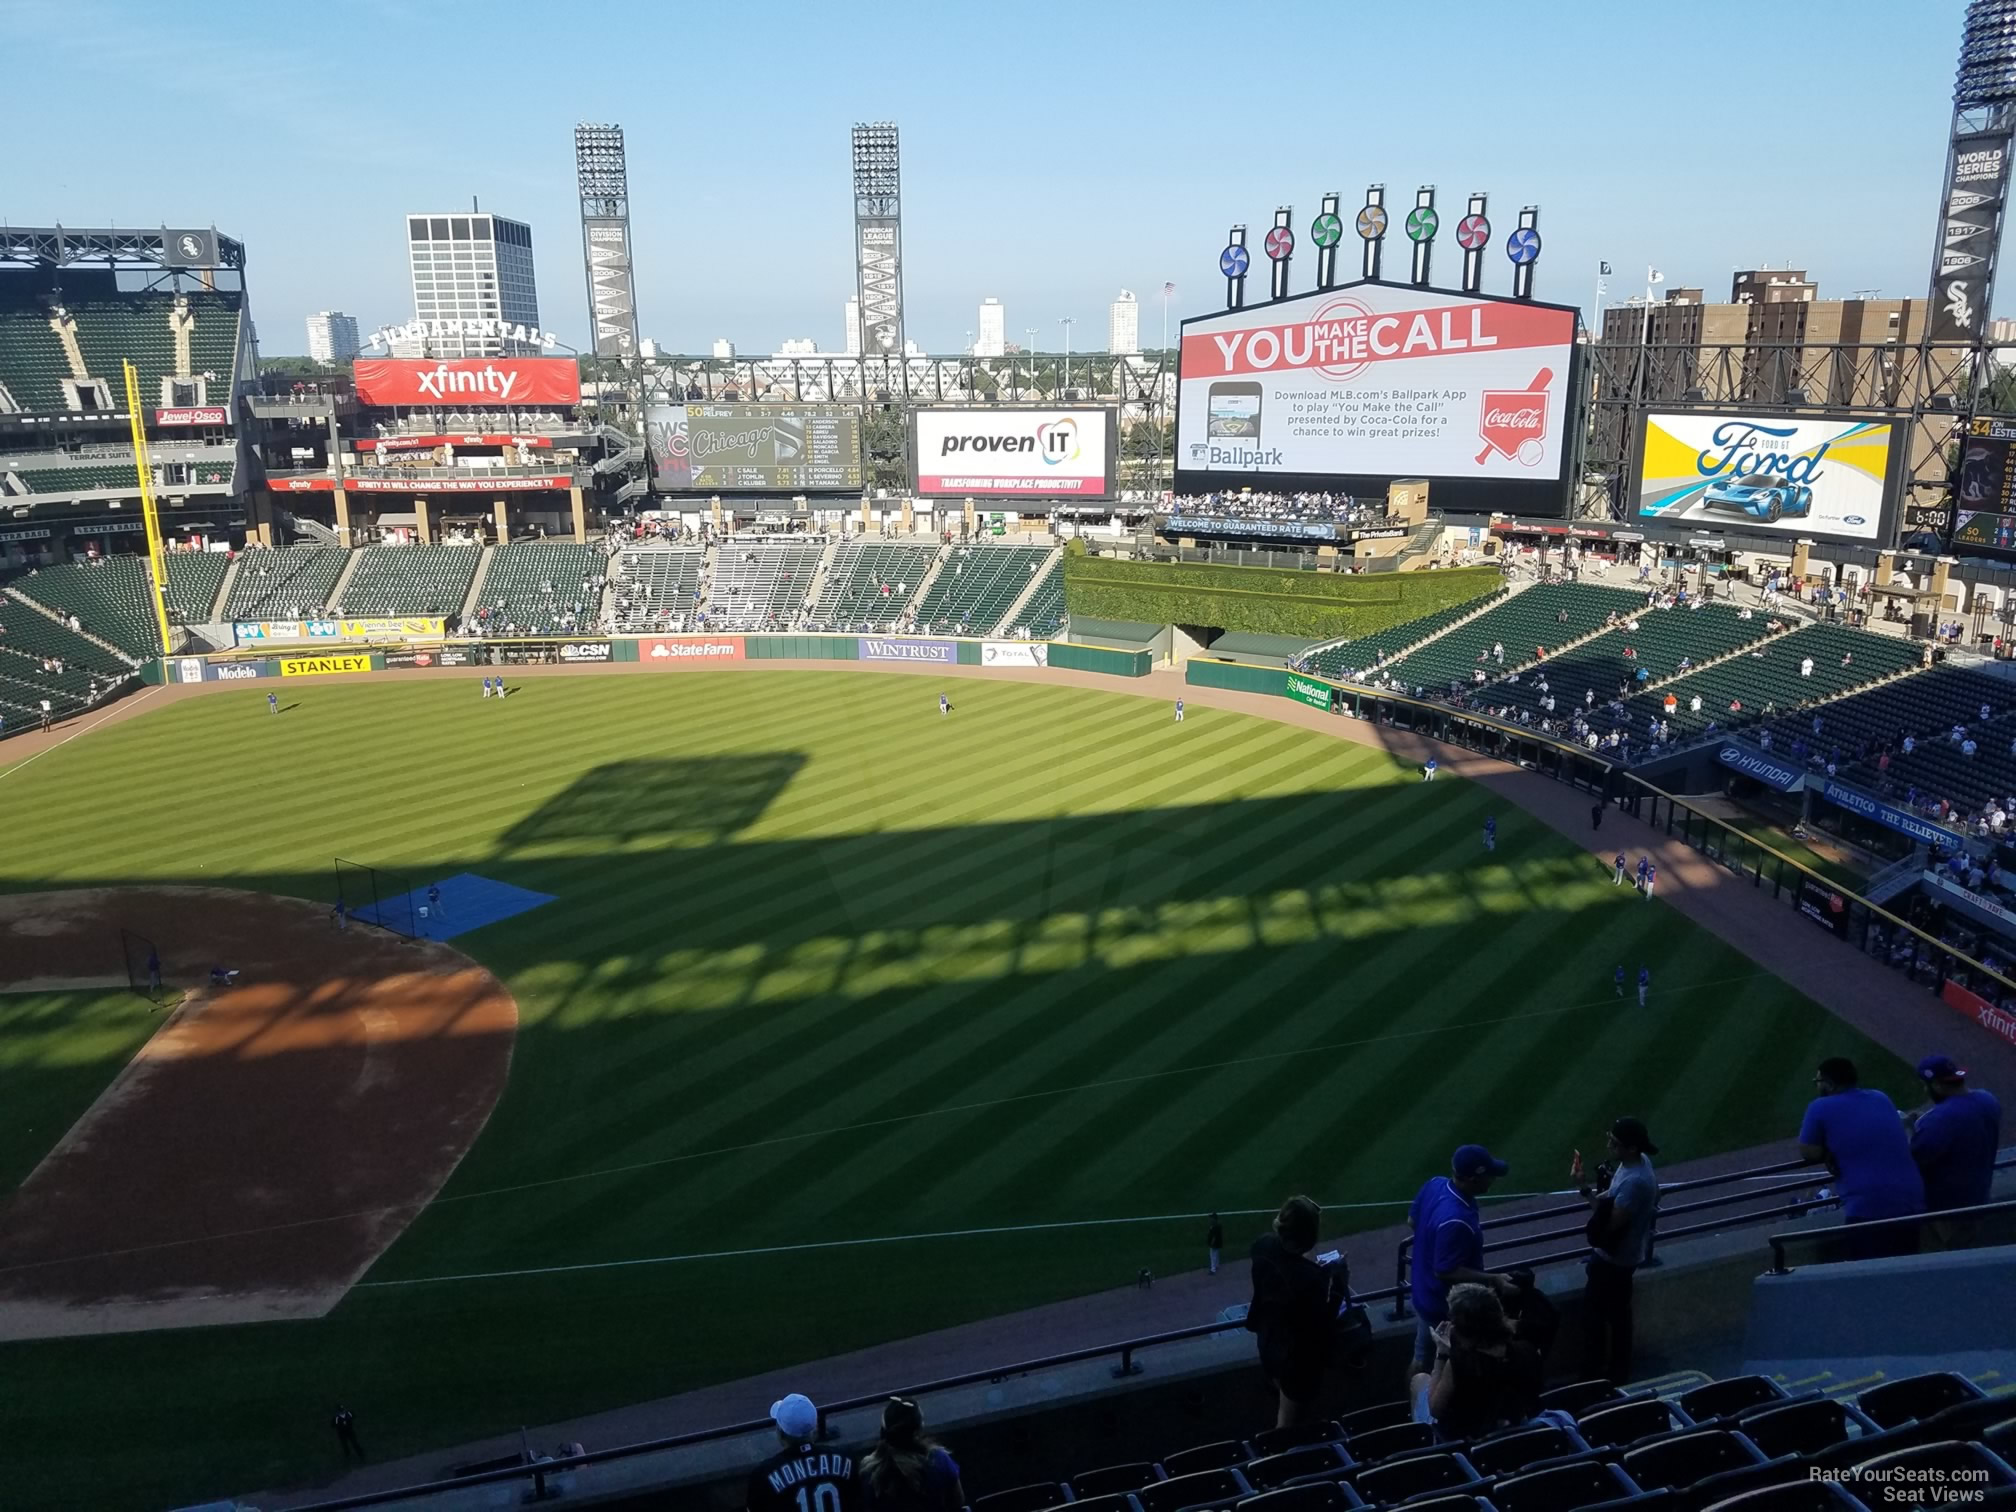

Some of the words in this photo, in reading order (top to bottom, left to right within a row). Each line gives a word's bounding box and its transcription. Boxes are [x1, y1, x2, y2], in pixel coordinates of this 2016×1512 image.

[1957, 150, 2002, 164] WORLD
[1956, 161, 2000, 175] SERIES
[1955, 173, 1999, 183] CHAMPIONS
[1951, 196, 1980, 206] 2005
[1949, 226, 1977, 236] 1917
[1945, 256, 1972, 266] 1906
[368, 321, 557, 350] FUNDAMENTALS
[1314, 319, 1368, 340] MAKE
[1369, 308, 1498, 354] CALL
[1215, 325, 1313, 371] YOU
[1314, 336, 1368, 362] THE
[417, 365, 518, 399] xfinity
[1274, 390, 1328, 401] Download
[1331, 389, 1389, 400] MLB.com's
[1392, 389, 1440, 402] Ballpark
[1442, 389, 1467, 401] App
[688, 407, 703, 417] 50
[1292, 402, 1304, 412] to
[1306, 402, 1329, 415] play
[1362, 402, 1391, 413] Make
[1396, 402, 1415, 412] the
[160, 410, 223, 423] Jewel-Osco
[1287, 415, 1340, 427] presented
[1343, 415, 1357, 427] by
[1360, 414, 1418, 425] Coca-Cola
[1421, 414, 1438, 425] for
[1441, 417, 1447, 425] a
[1485, 408, 1541, 429] Coca-Cola
[1292, 427, 1330, 437] chance
[1332, 427, 1344, 437] to
[1347, 427, 1367, 437] win
[1369, 428, 1398, 439] great
[1402, 427, 1440, 439] prizes!
[1971, 421, 1990, 435] 34
[692, 425, 773, 458] Chicago
[941, 434, 1035, 457] proven
[1049, 432, 1070, 452] IT
[1761, 440, 1779, 449] FORD
[1781, 440, 1790, 450] GT
[69, 453, 107, 461] TERRACE
[1210, 447, 1283, 468] Ballpark
[1697, 421, 1832, 485] Ford
[289, 480, 312, 490] xfinity
[411, 481, 441, 489] CHANGE
[496, 480, 542, 488] EXPERIENCE
[941, 478, 993, 488] TRANSFORMING
[993, 478, 1034, 489] WORKPLACE
[1034, 479, 1084, 490] PRODUCTIVITY
[1916, 510, 1946, 526] 6:00
[83, 525, 115, 533] EXTRA
[117, 523, 141, 531] BASE
[1170, 519, 1209, 529] WELCOME
[1211, 521, 1221, 529] TO
[1223, 522, 1277, 532] GUARANTEED
[1279, 525, 1301, 533] RATE
[1303, 526, 1328, 534] FIELD
[1967, 527, 1979, 536] SO
[25, 530, 49, 538] BASE
[1370, 530, 1404, 538] PrivateBank
[1958, 535, 1986, 543] LEADERS
[272, 623, 291, 631] Bring
[579, 644, 611, 656] CSN
[866, 641, 949, 658] WINTRUST
[288, 658, 364, 673] STANLEY
[386, 656, 416, 664] guaranteed
[416, 653, 430, 661] Rate
[217, 666, 257, 680] Modelo
[1296, 681, 1329, 702] National
[1737, 754, 1794, 785] HYUNDAI
[1827, 784, 1876, 813] ATHLETICO
[1881, 810, 1900, 826] THE
[1901, 818, 1959, 849] RELIEVERS
[1978, 1006, 2016, 1046] xfinit
[768, 1454, 852, 1493] MONCADA
[797, 1482, 841, 1512] 10
